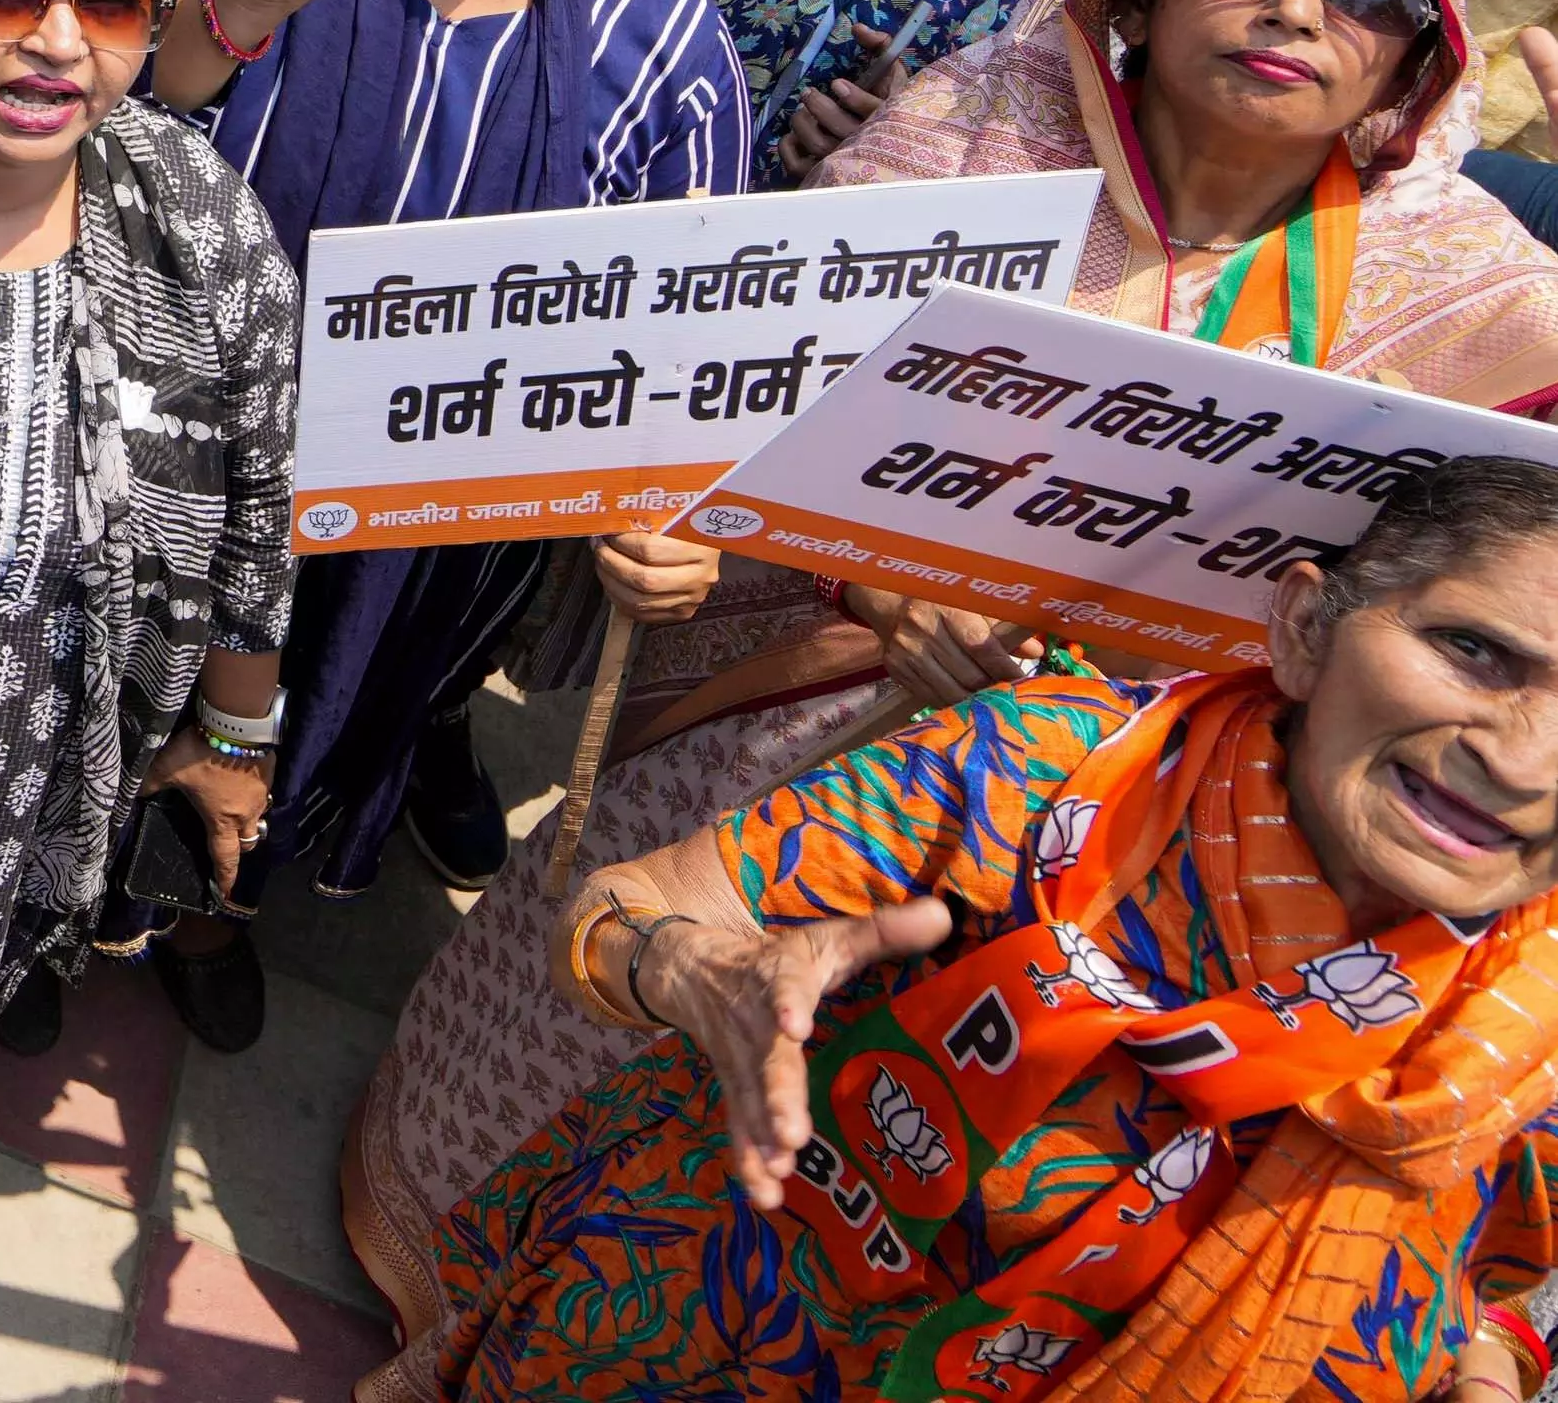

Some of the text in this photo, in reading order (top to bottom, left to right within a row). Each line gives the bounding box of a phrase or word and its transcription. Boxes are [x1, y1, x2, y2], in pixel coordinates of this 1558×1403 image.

[325, 230, 1060, 341] महिला विरोधी अरविंद केजरीवाल
[387, 358, 507, 442] शर्म
[884, 343, 1089, 417] महिला
[1069, 381, 1283, 461] विरोधी
[368, 502, 460, 526] भारतीय
[466, 500, 543, 520] जनता
[861, 442, 1053, 505] शर्म
